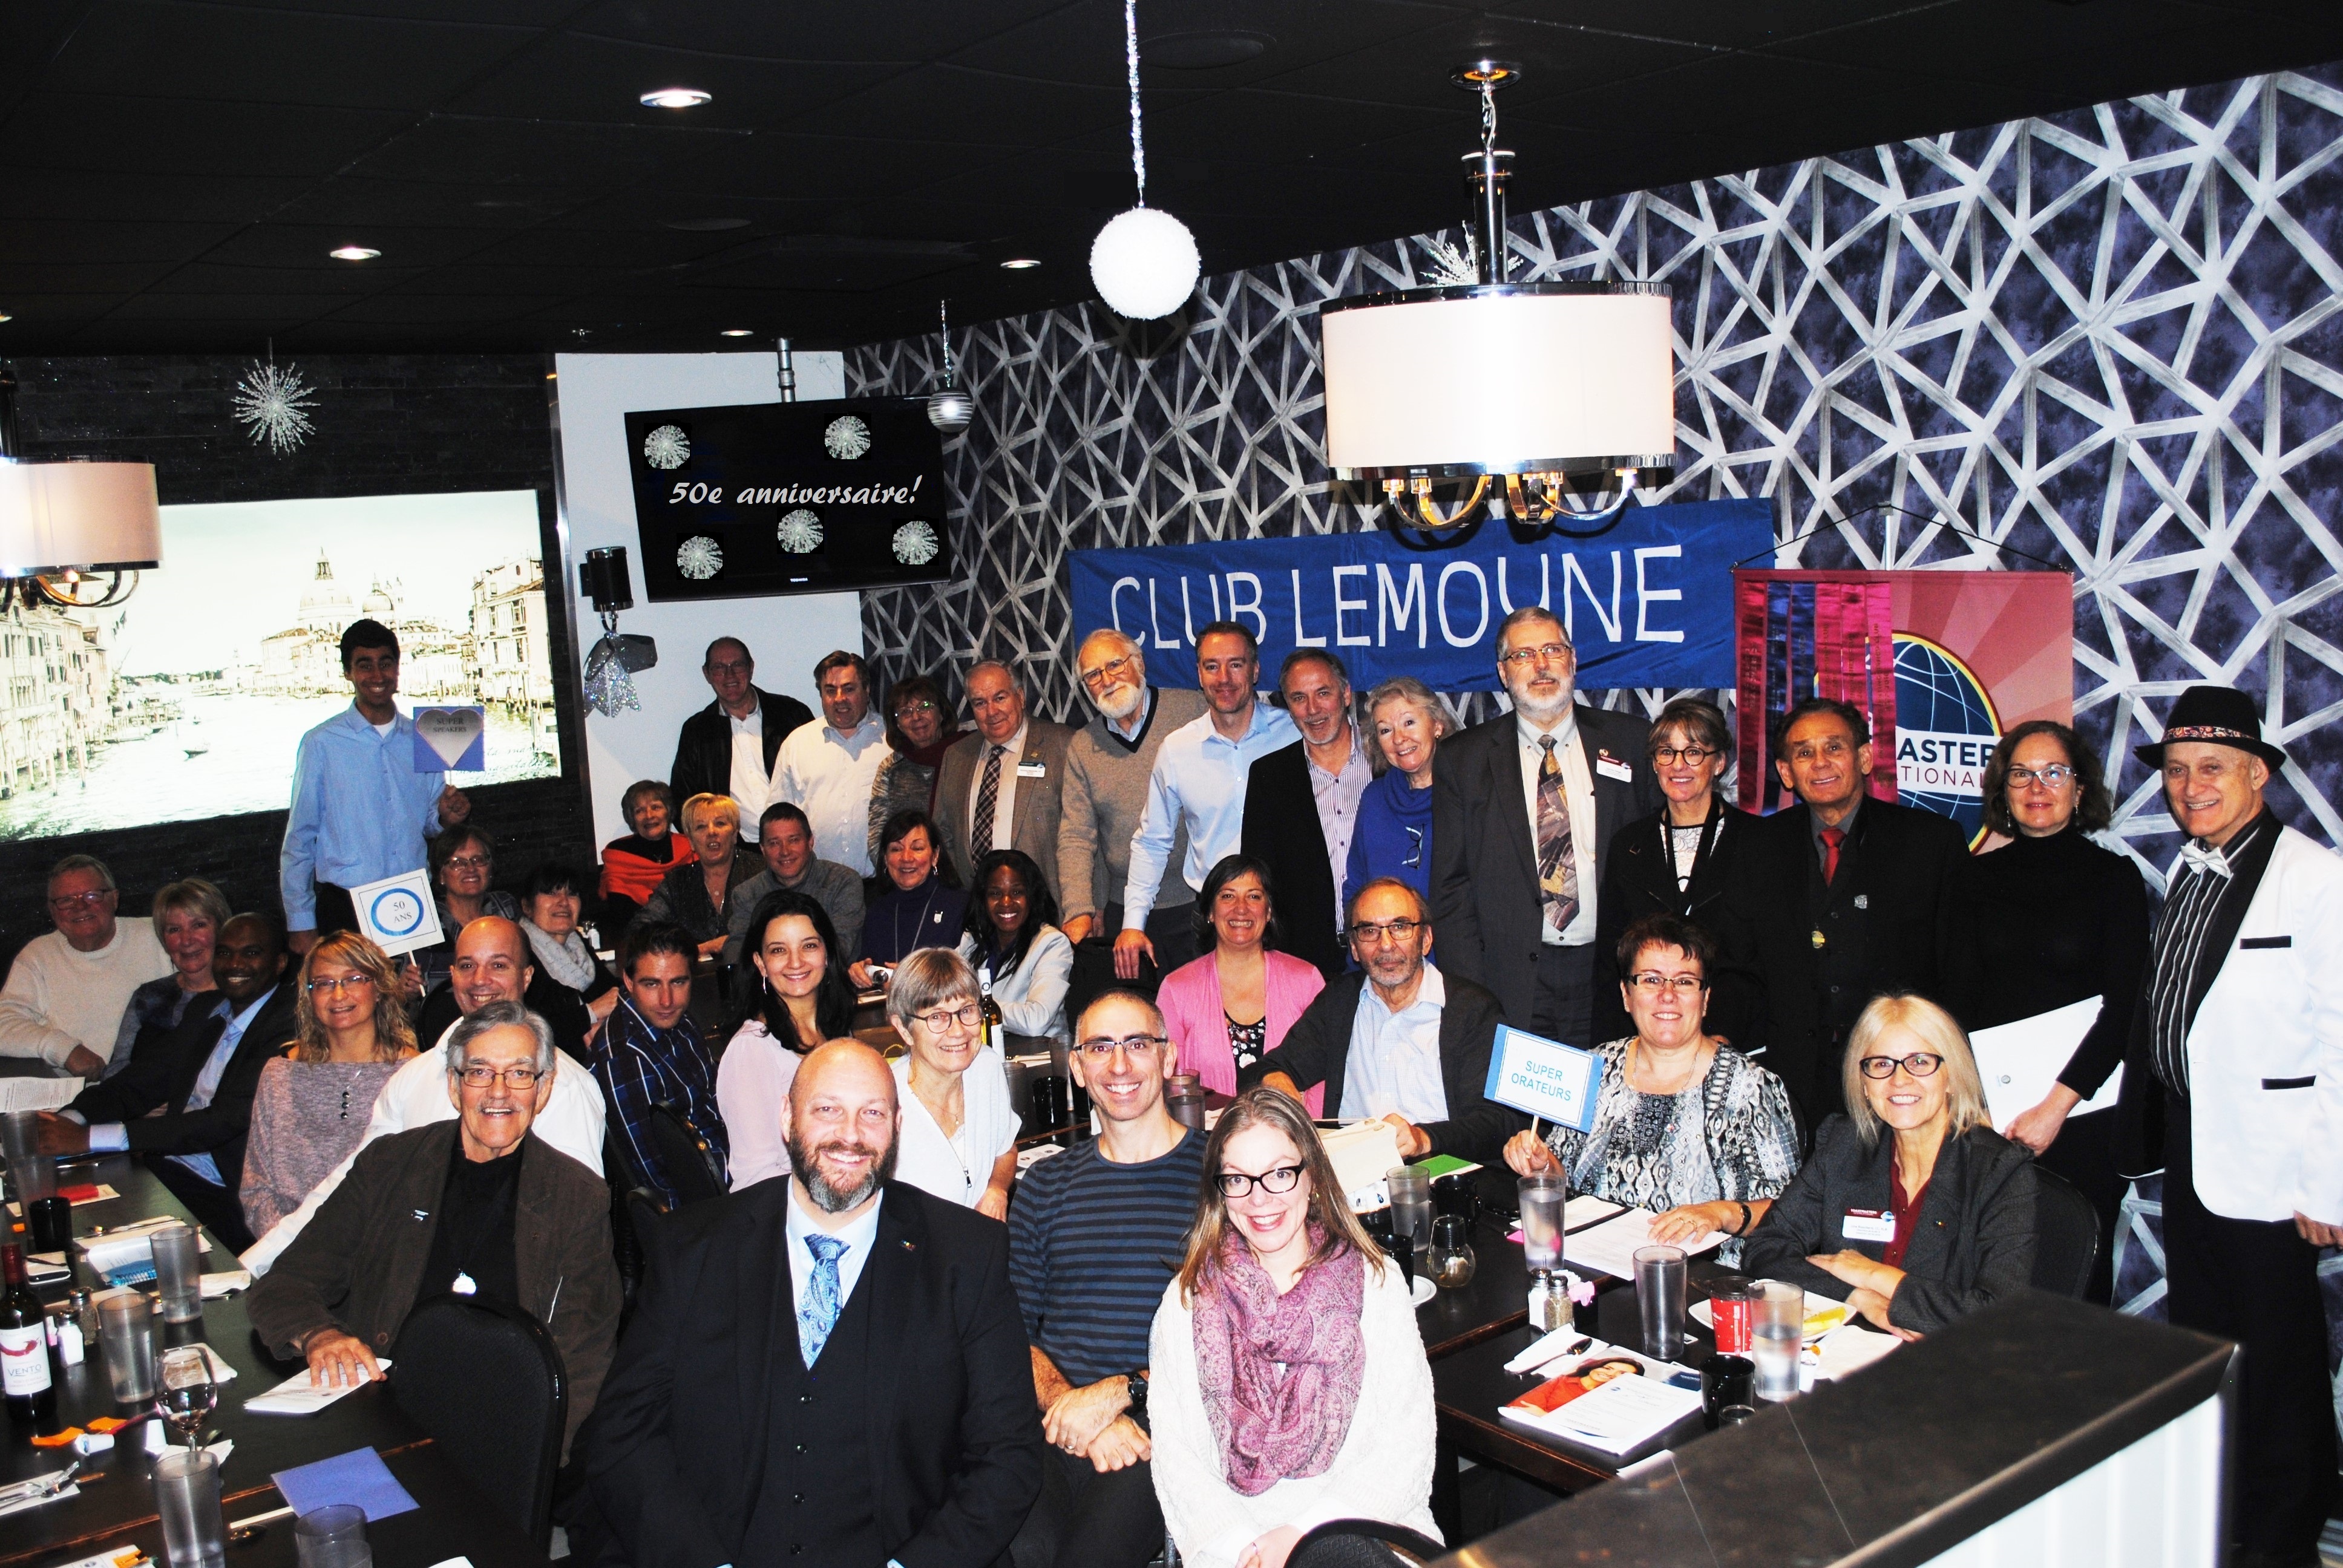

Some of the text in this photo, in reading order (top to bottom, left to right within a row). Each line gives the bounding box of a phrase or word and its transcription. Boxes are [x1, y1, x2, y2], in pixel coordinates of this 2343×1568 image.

[1111, 572, 1267, 649] CLUB
[436, 717, 464, 725] SUPER
[1897, 737, 1996, 768] ASTER
[1899, 765, 1984, 788] TIONAL
[393, 900, 405, 911] 50
[395, 912, 412, 923] ANS
[1525, 1060, 1563, 1082] SUPER
[1512, 1073, 1571, 1101] ORATEURS
[7, 1364, 42, 1376] VENTO
